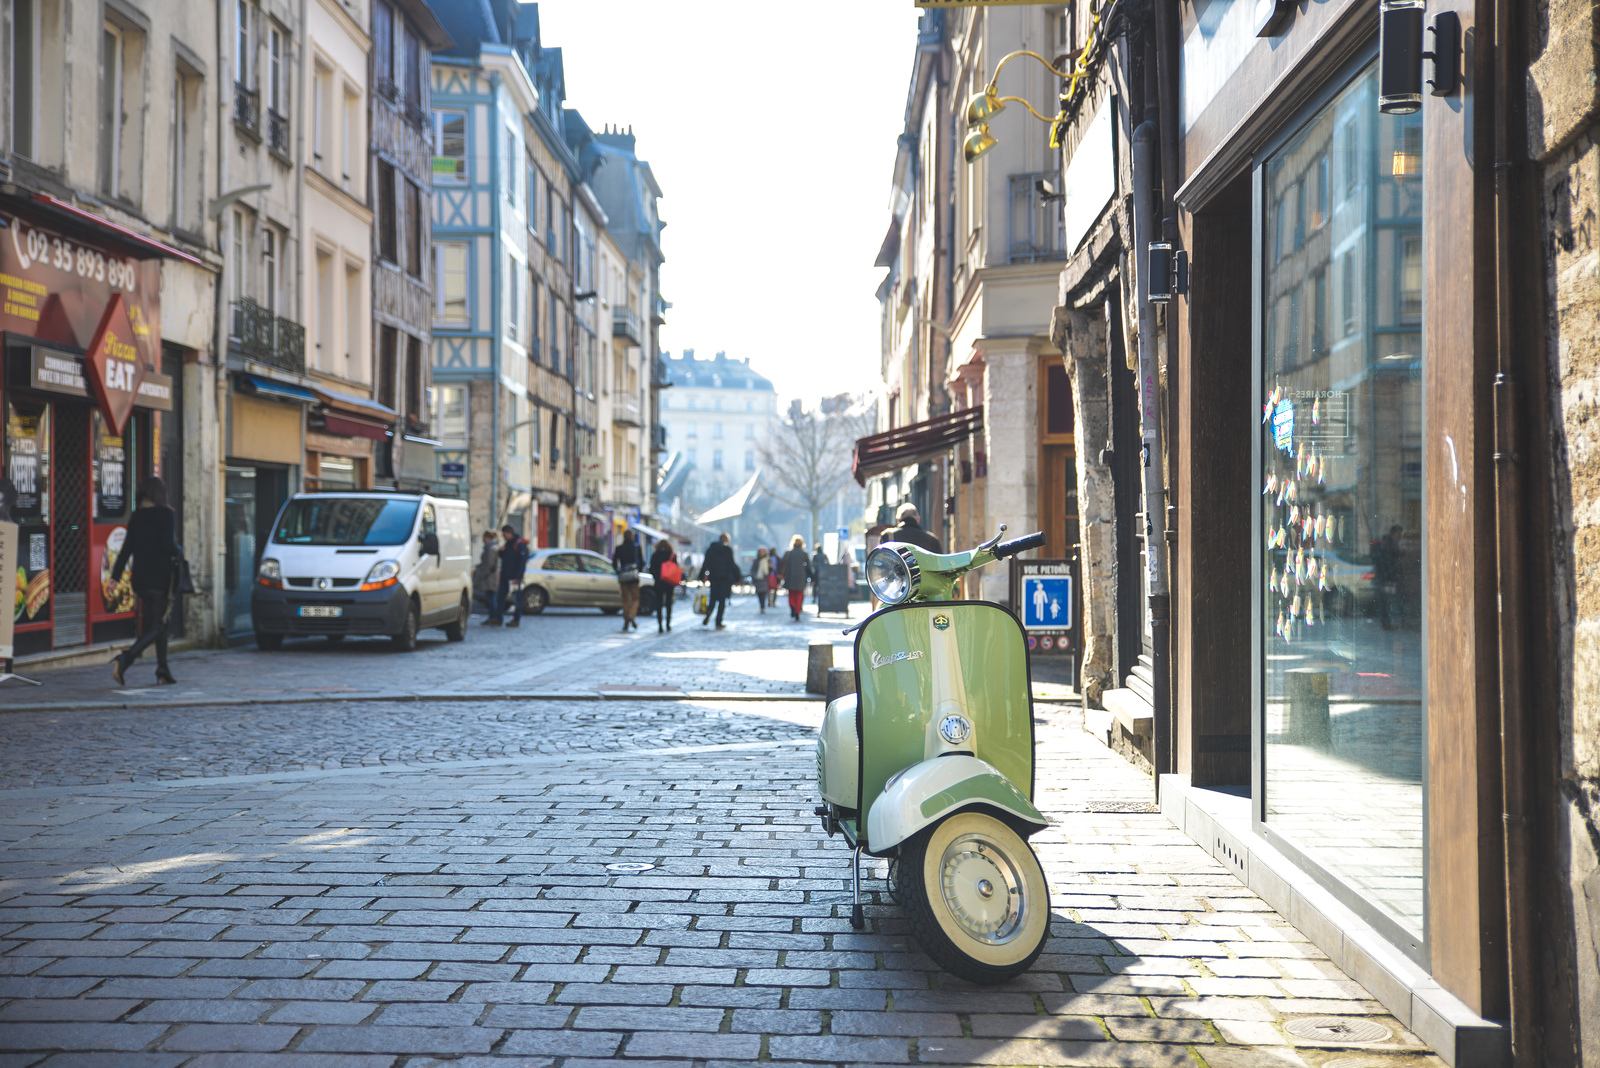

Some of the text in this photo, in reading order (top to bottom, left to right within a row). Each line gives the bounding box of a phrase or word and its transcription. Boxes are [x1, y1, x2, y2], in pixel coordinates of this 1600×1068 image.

[27, 229, 136, 292] 02 35 893 890
[105, 358, 136, 392] EAT
[1023, 565, 1039, 574] VOIE
